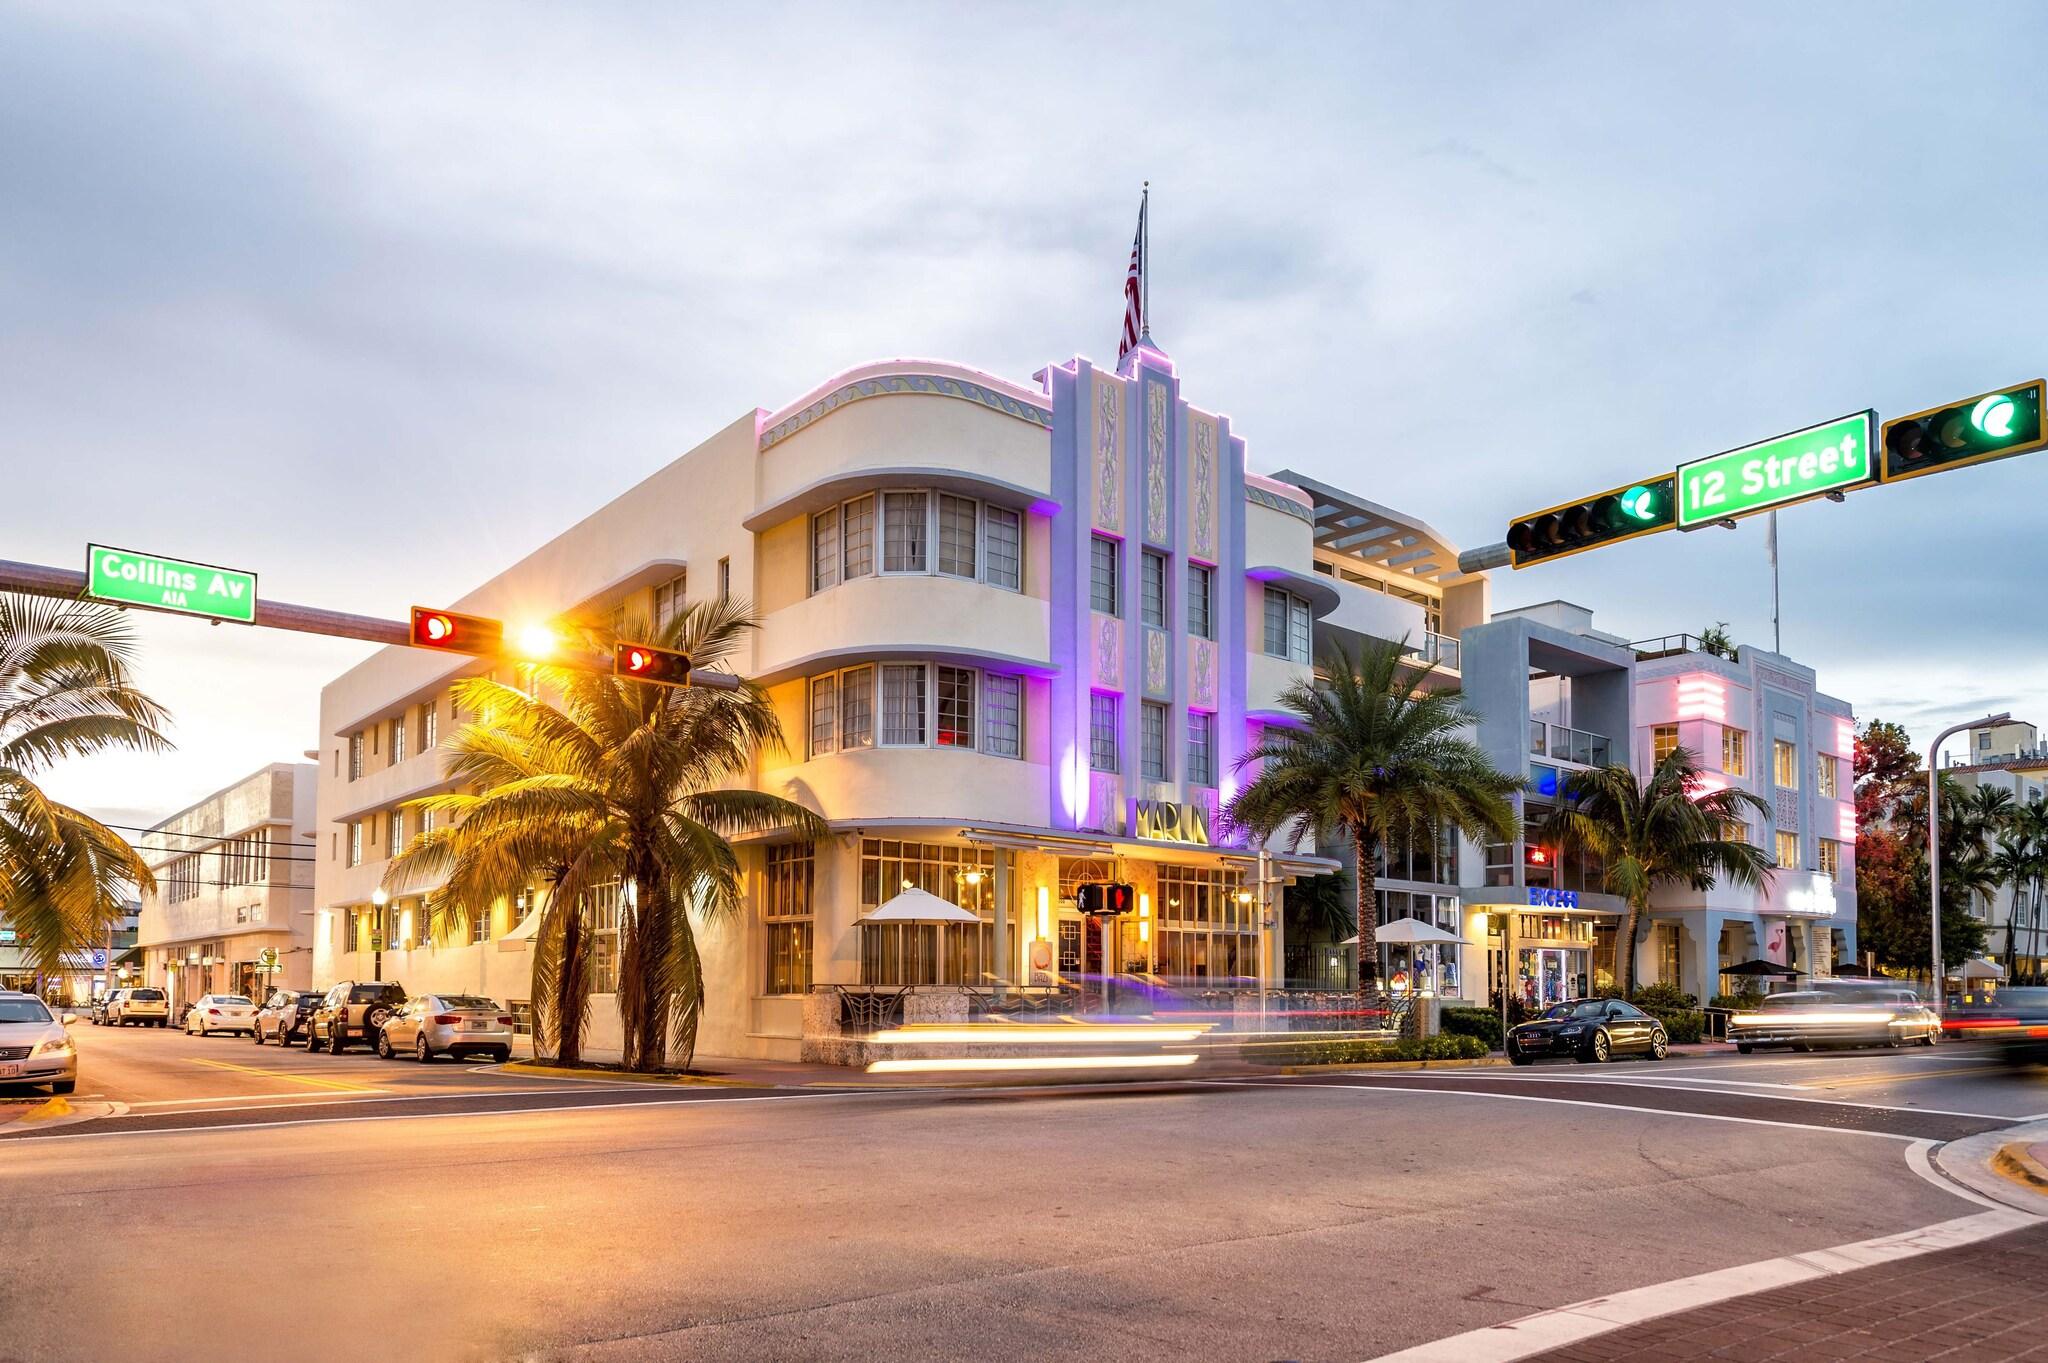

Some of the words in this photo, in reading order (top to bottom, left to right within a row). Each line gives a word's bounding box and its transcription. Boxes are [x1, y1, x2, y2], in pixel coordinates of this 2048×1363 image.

[1690, 472, 1725, 509] 12
[1742, 434, 1857, 494] Street
[103, 556, 196, 590] Collins
[209, 574, 244, 598] Av
[1136, 800, 1208, 845] MARLIN
[1530, 888, 1578, 908] EXCESS
